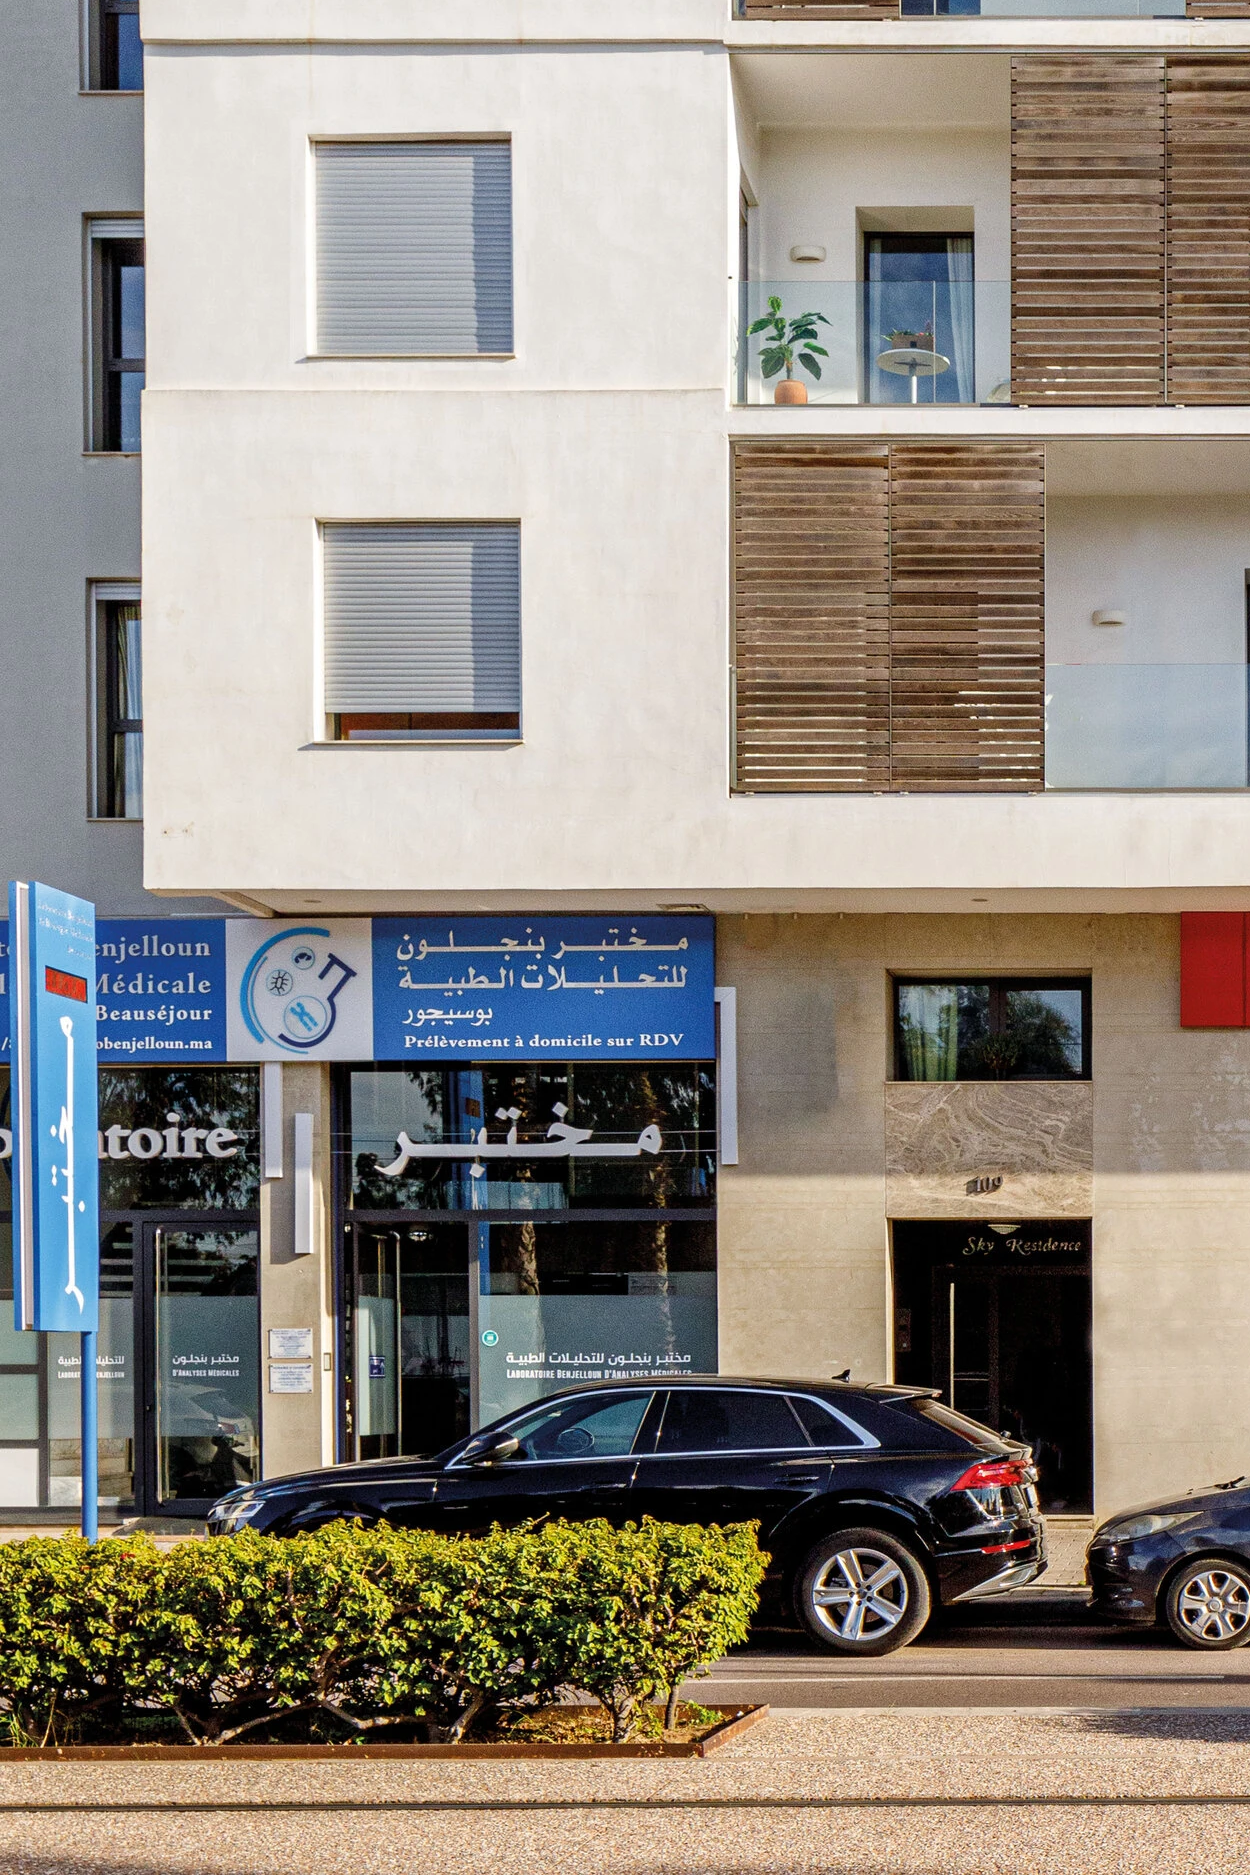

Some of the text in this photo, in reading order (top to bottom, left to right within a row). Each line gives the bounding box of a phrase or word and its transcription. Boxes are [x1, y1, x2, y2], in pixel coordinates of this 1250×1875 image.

[95, 935, 211, 963] enjelloun
[396, 928, 689, 960] مختبر بنجلون
[399, 965, 688, 997] للتحليلات الطبية
[96, 1004, 213, 1026] Beauséjour
[402, 1006, 493, 1027] بوسيجور
[97, 1036, 213, 1054] obenjelloun.ma
[404, 1034, 684, 1048] Prélèvement à domicile sur RDV
[374, 1102, 663, 1177] مختبر
[962, 1236, 1081, 1256] Sky Residence
[172, 1354, 239, 1365] مختبر بنجلون
[506, 1352, 691, 1366] مختبر بنجلون للتحليلات الطبية
[507, 1370, 555, 1379] LABORATOIRE
